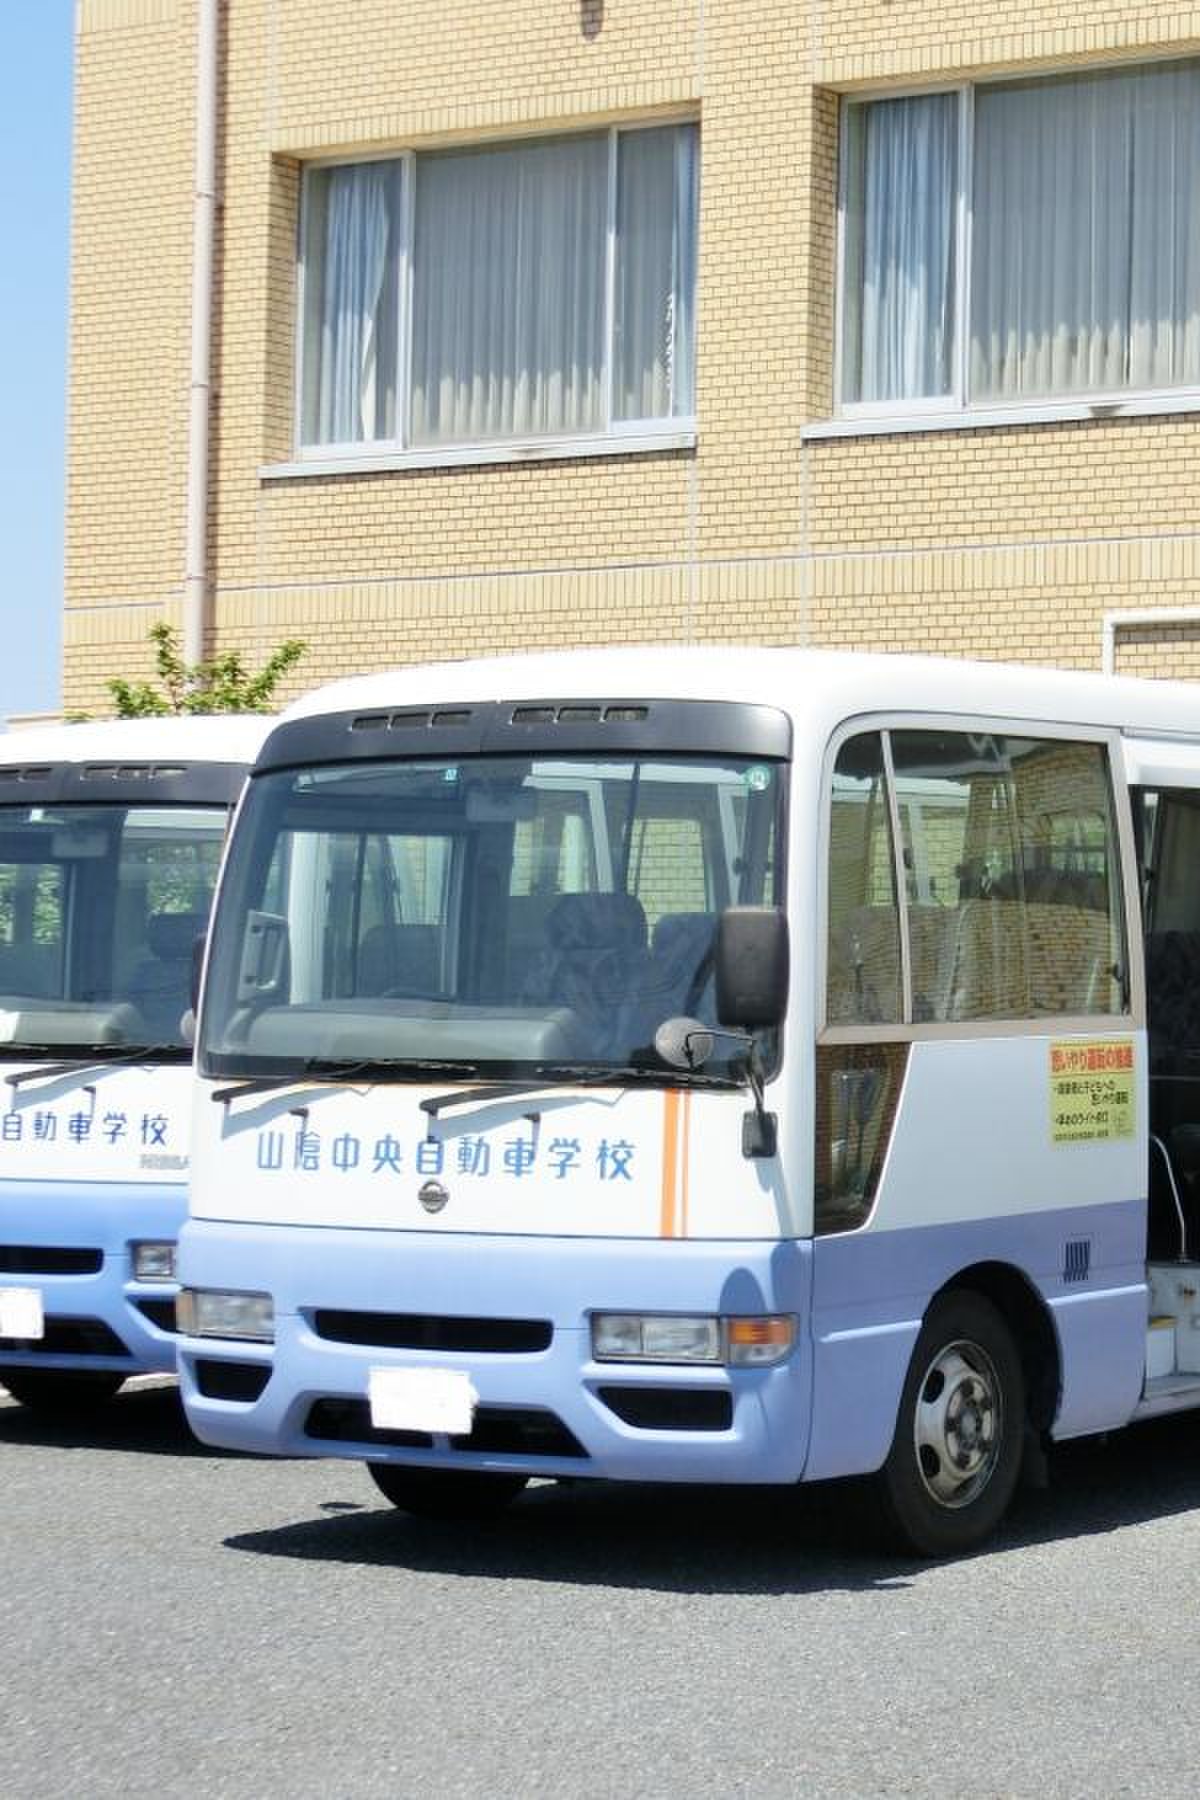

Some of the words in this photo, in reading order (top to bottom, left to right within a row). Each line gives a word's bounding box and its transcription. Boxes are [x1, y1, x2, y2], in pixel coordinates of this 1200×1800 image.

[2, 1111, 170, 1146] 自動車学校
[256, 1130, 638, 1181] 山陰中央自動車学校
